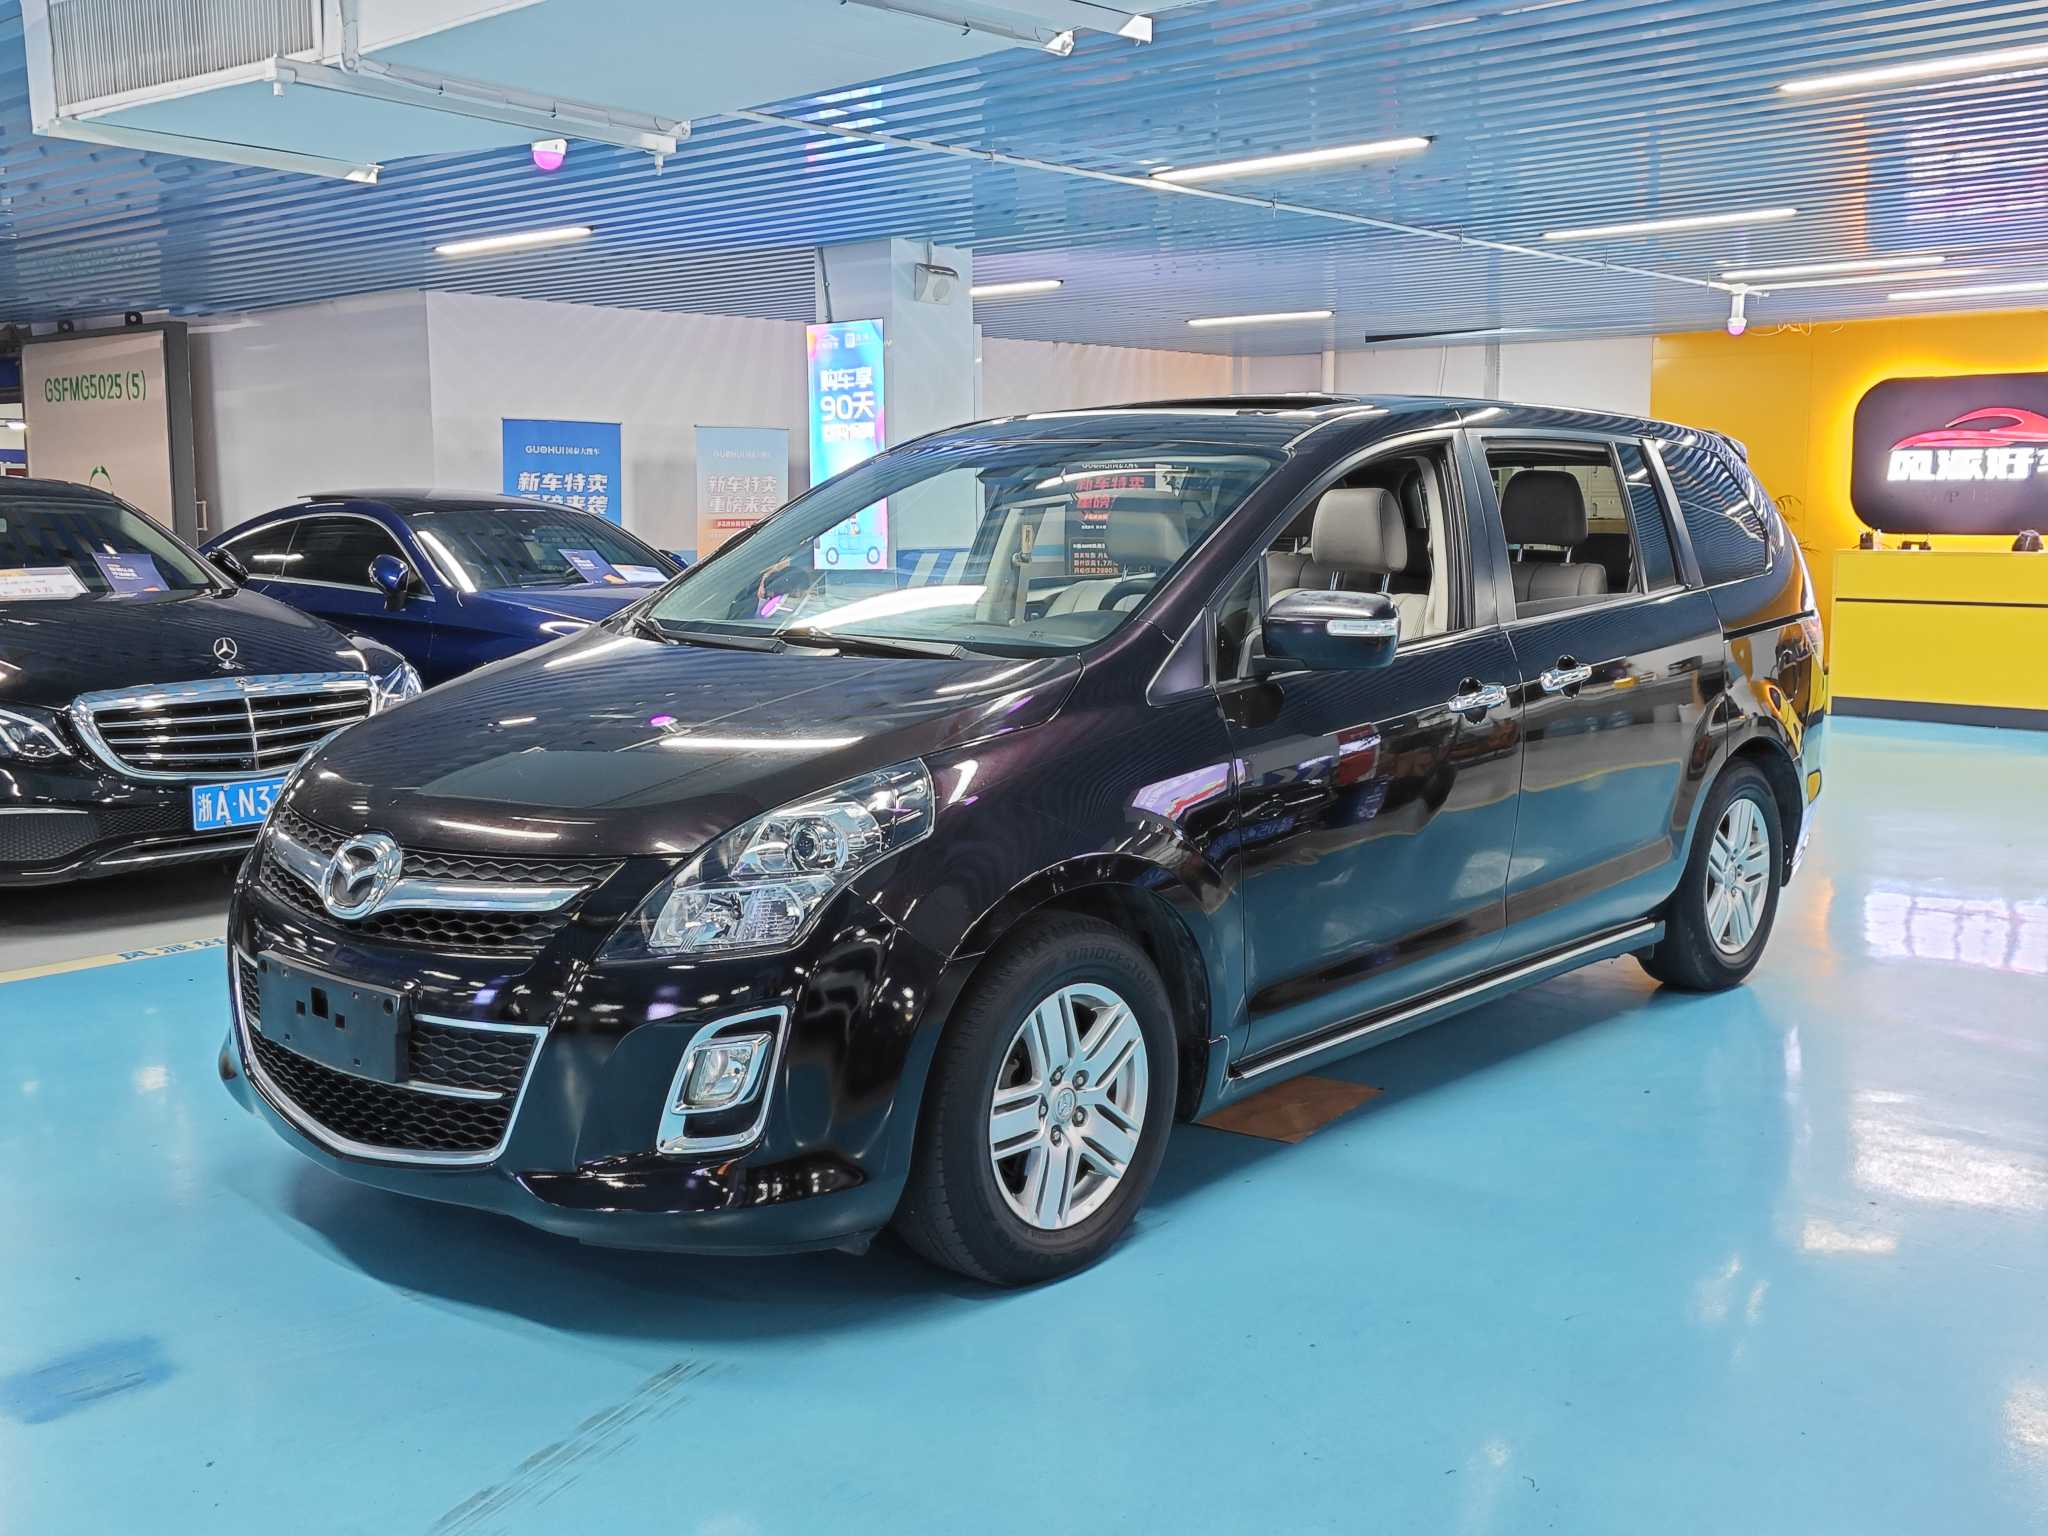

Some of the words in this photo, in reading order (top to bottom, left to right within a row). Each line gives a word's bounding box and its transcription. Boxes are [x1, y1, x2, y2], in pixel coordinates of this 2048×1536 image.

[820, 367, 873, 391] 购车享
[820, 391, 875, 421] 90天
[1887, 447, 2048, 481] 风派好
[517, 471, 608, 493] 新车特卖
[709, 475, 777, 494] 新车特卖
[519, 493, 608, 515] 来袭
